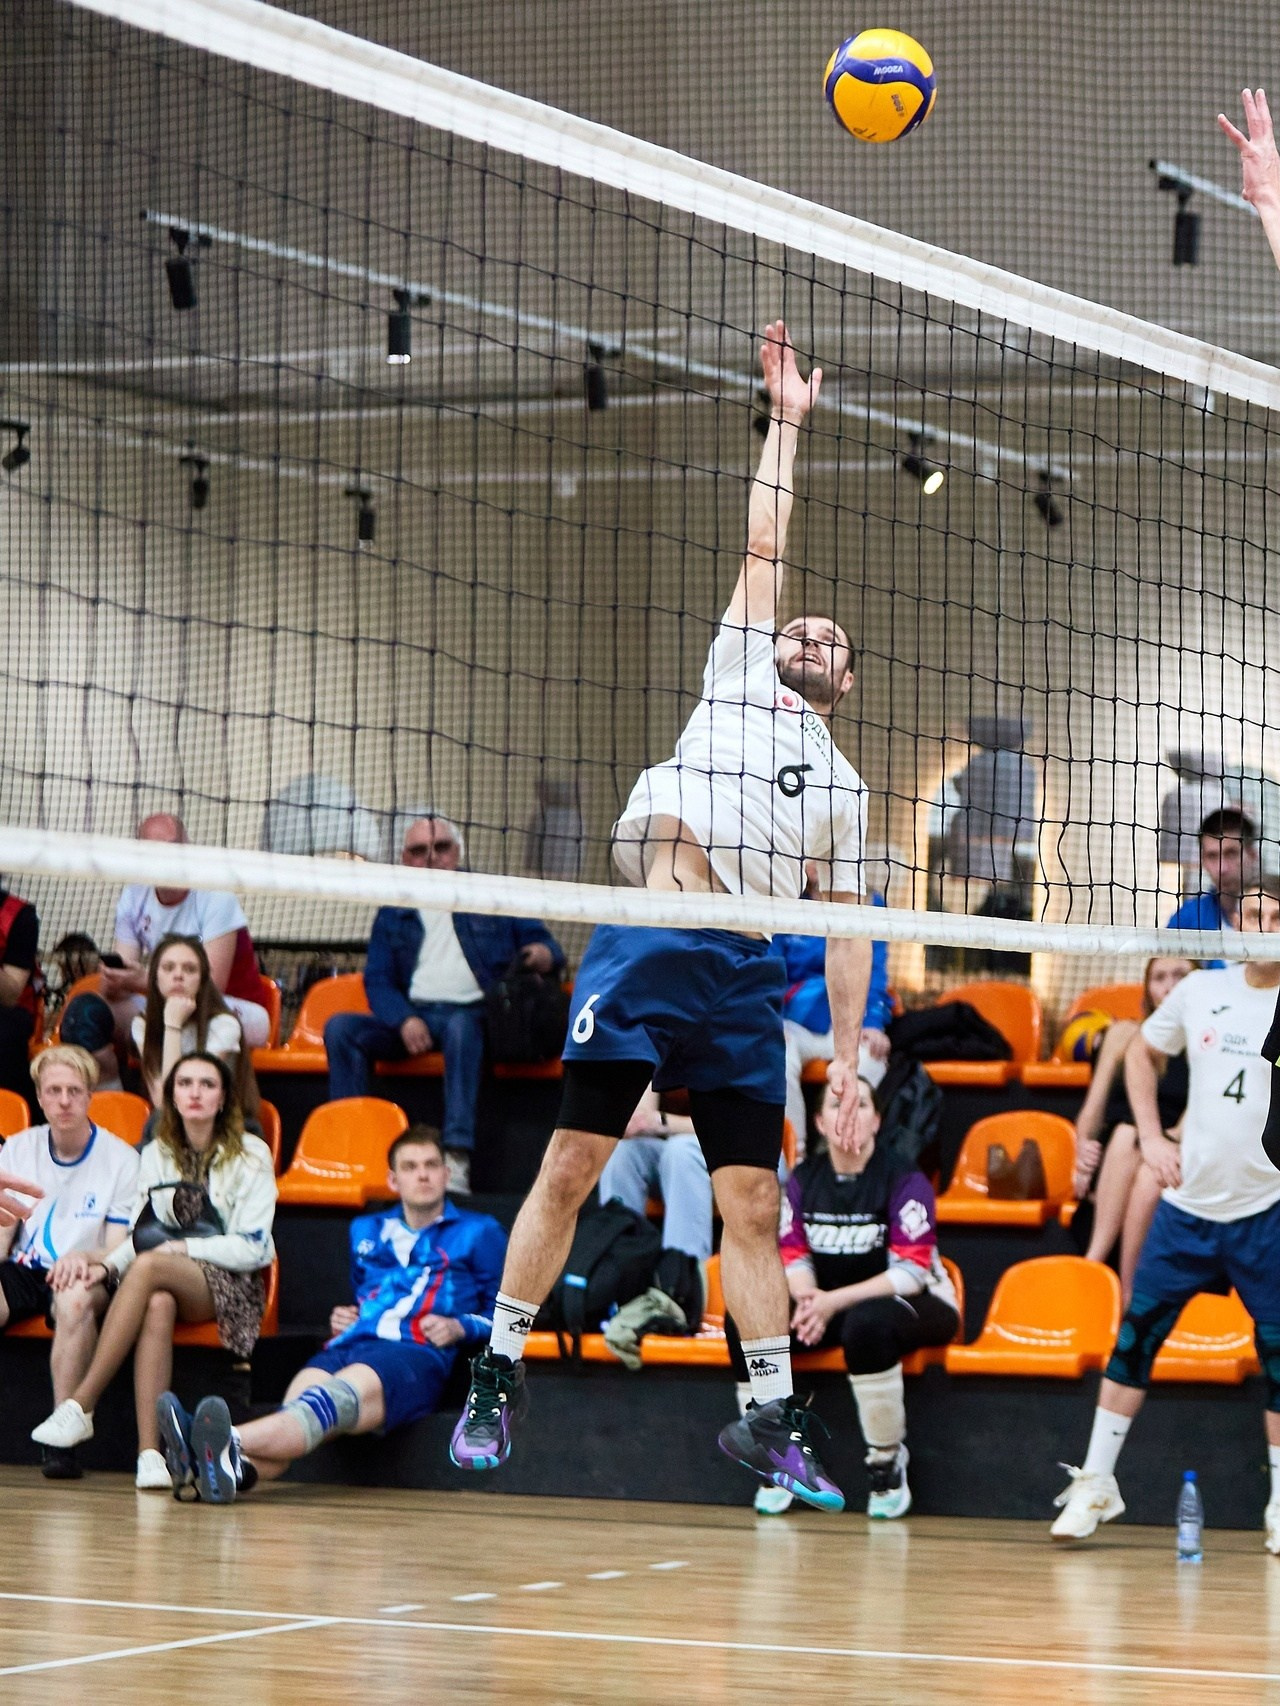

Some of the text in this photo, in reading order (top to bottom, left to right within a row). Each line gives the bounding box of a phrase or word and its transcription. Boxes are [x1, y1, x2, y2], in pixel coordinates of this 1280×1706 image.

[777, 763, 814, 798] 6
[571, 993, 601, 1044] 6
[1222, 1067, 1247, 1105] 4
